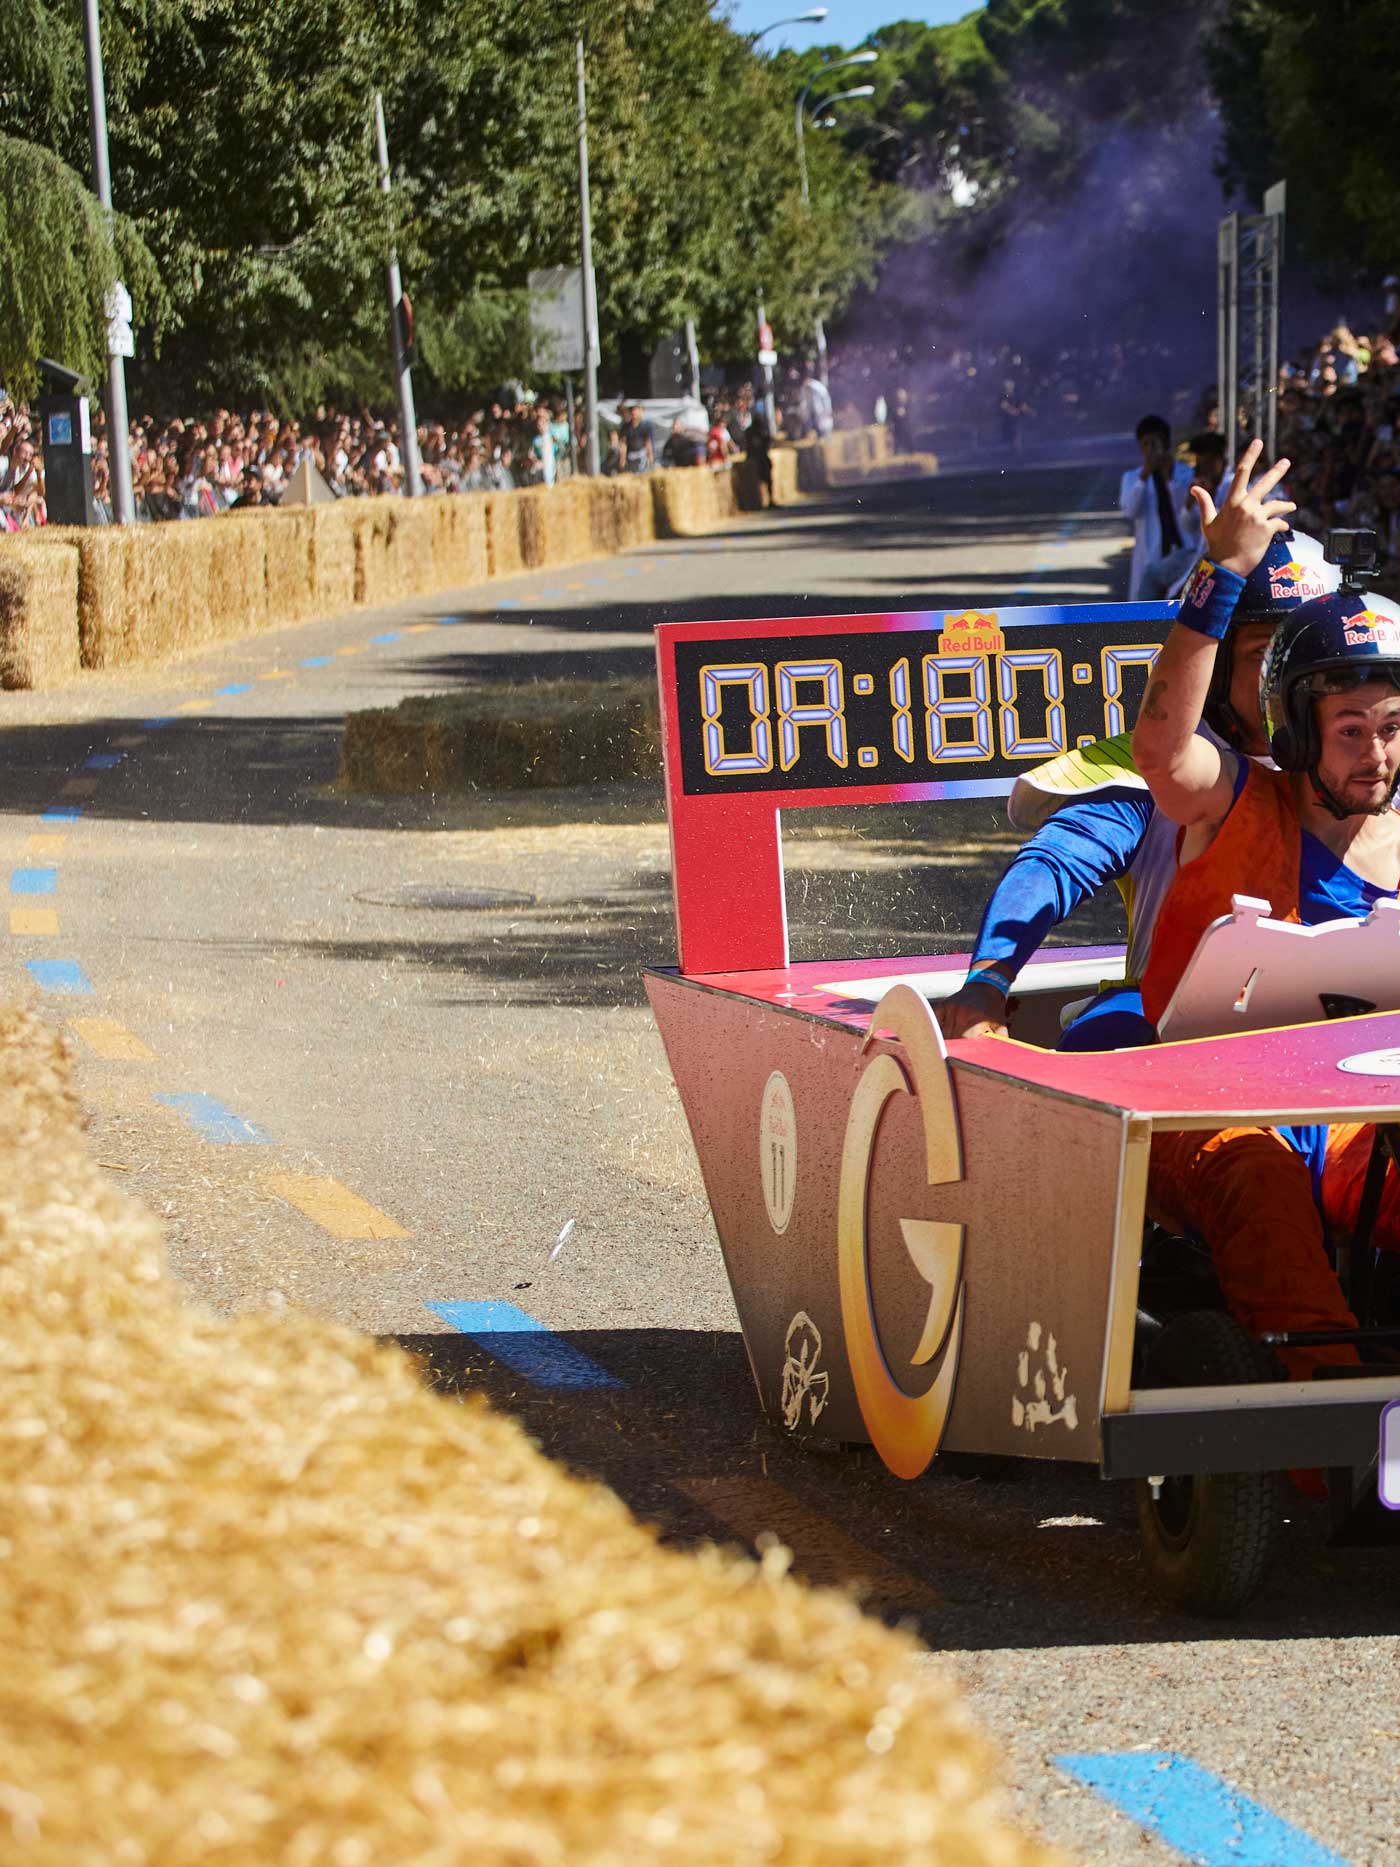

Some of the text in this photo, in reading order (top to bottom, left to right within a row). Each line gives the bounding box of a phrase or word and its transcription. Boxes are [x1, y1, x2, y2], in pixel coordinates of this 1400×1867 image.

[1272, 583, 1325, 598] Red Bull
[942, 635, 1001, 652] Red Bull
[1345, 630, 1376, 645] Red
